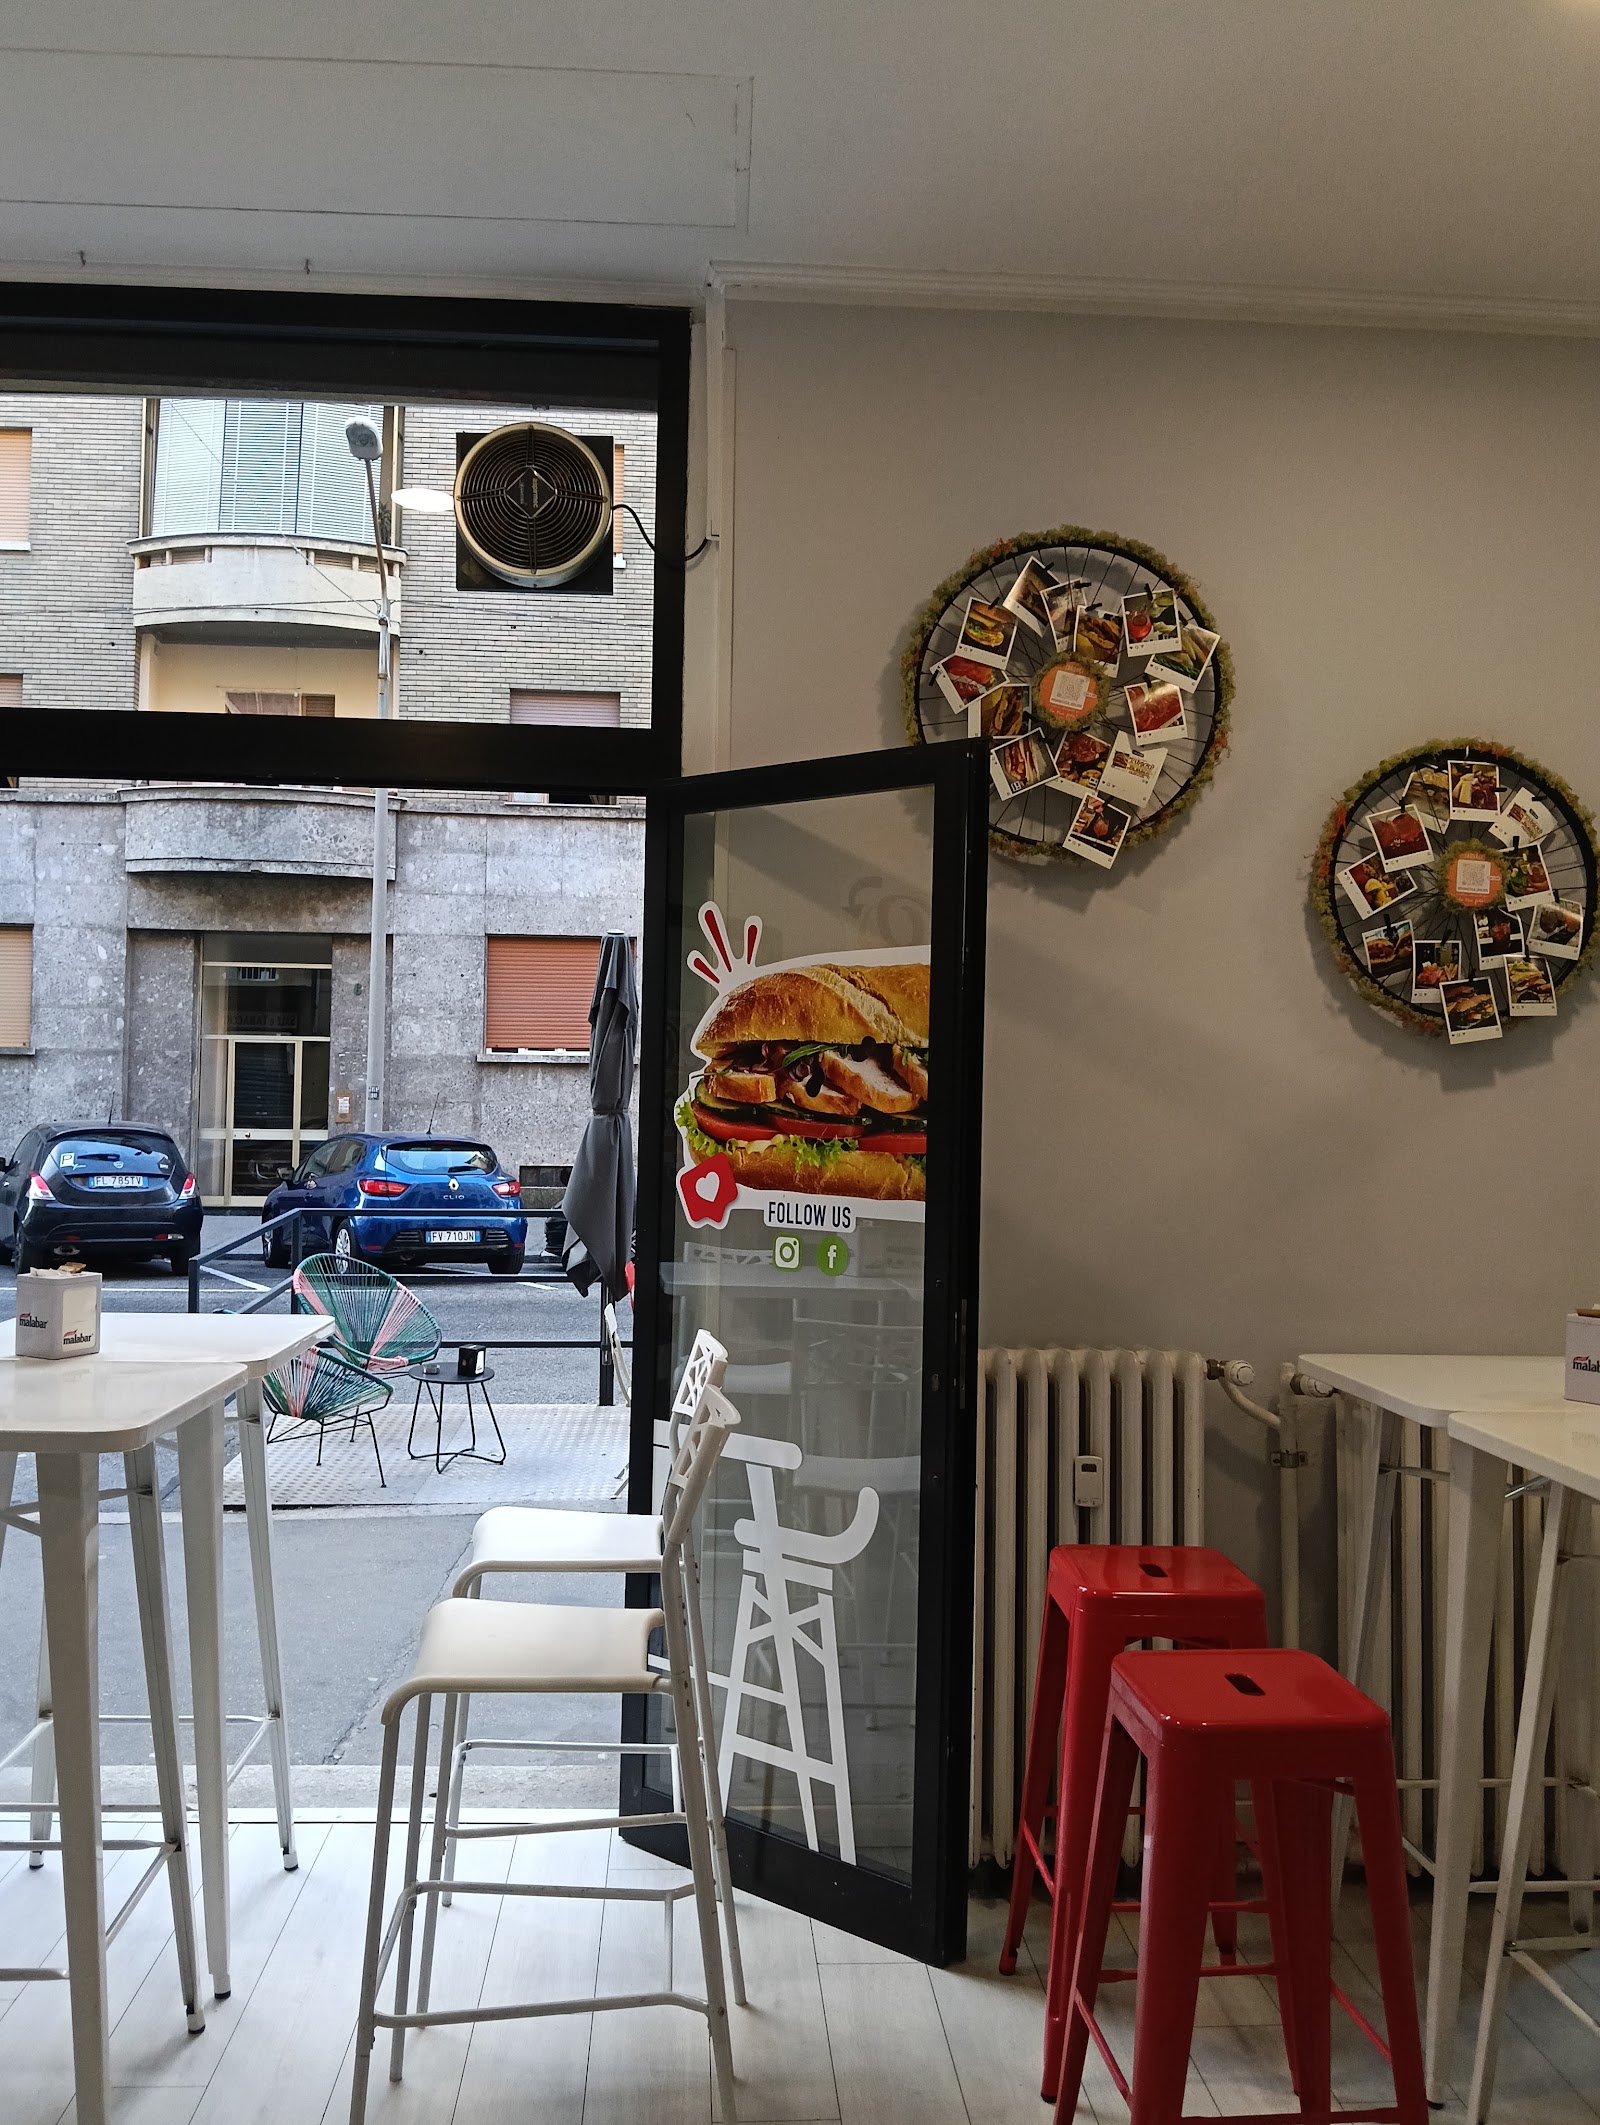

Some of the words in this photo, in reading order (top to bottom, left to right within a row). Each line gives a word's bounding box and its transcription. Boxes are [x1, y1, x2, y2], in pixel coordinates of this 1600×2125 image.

[95, 1176, 108, 1186] FL
[111, 1176, 142, 1185] 785TV
[768, 1201, 827, 1226] FOLLOW
[832, 1205, 851, 1228] US
[432, 1231, 443, 1242] FV
[446, 1231, 474, 1242] 710JN
[19, 1316, 48, 1329] malabar
[63, 1333, 92, 1345] malabar
